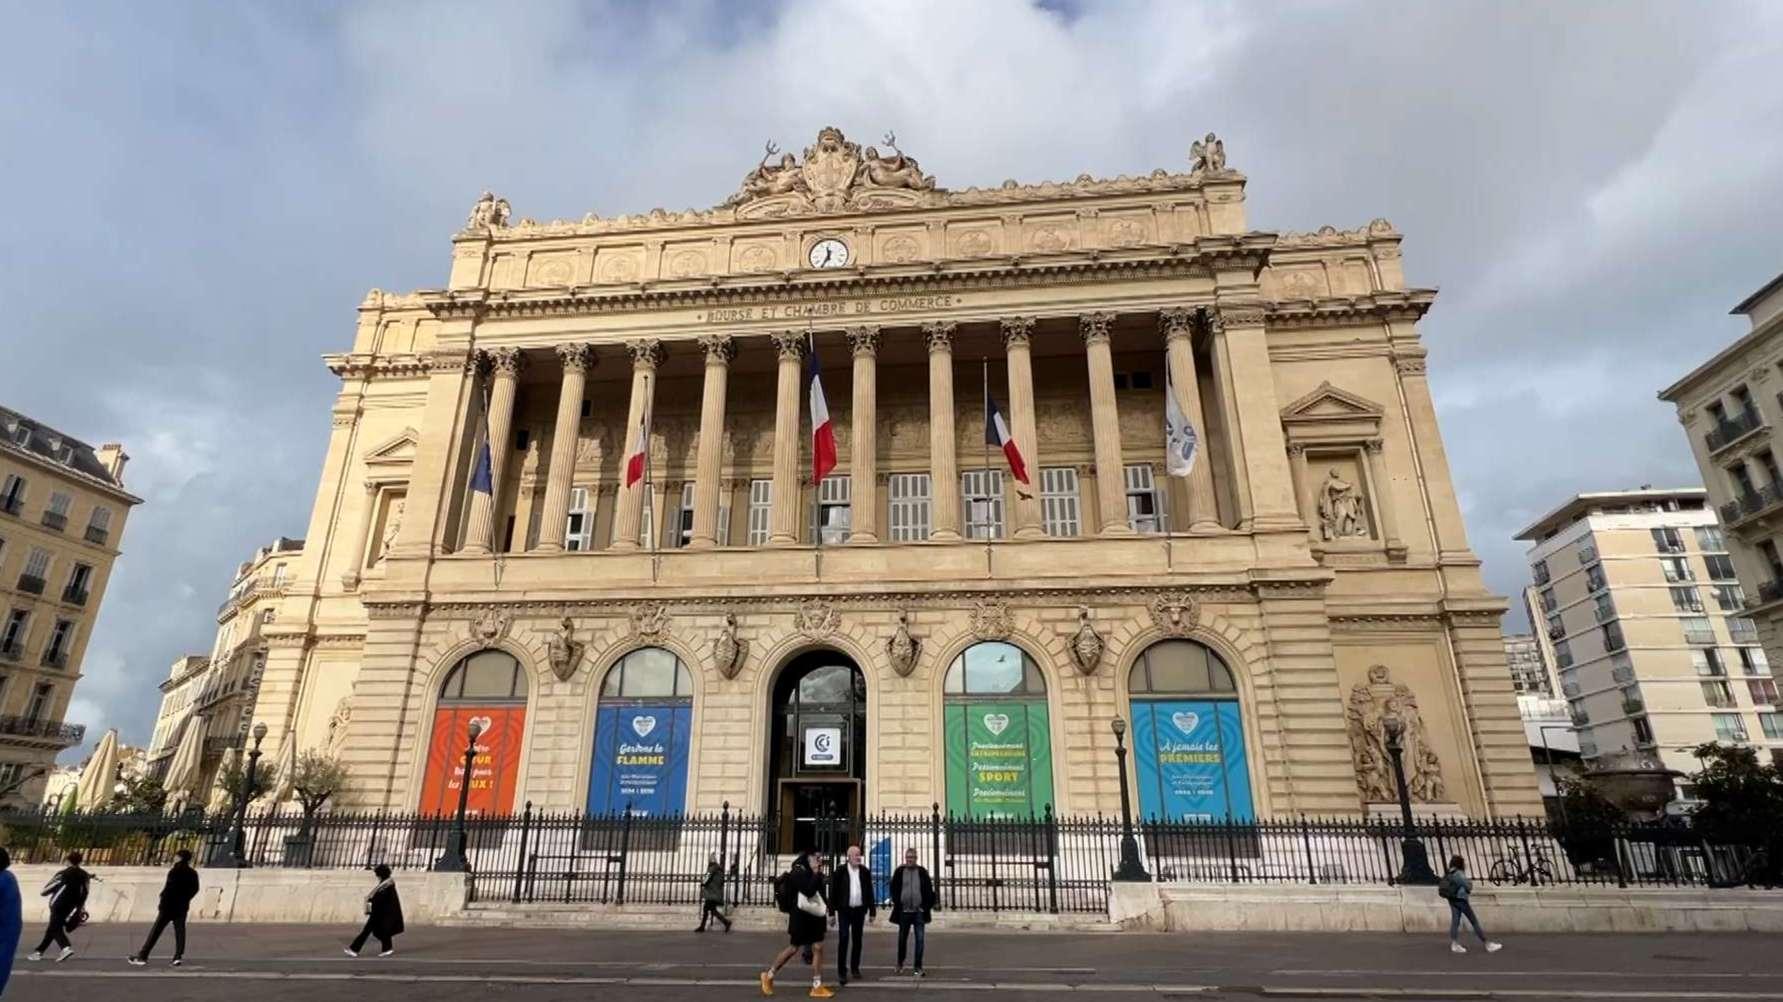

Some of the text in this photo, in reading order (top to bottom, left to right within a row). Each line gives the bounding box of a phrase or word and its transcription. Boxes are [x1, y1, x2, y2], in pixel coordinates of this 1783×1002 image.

[707, 296, 951, 321] BOURSE ET CHAMBRE DE COMMERCE
[615, 756, 665, 765] FLAMME
[978, 772, 1019, 782] SPORT
